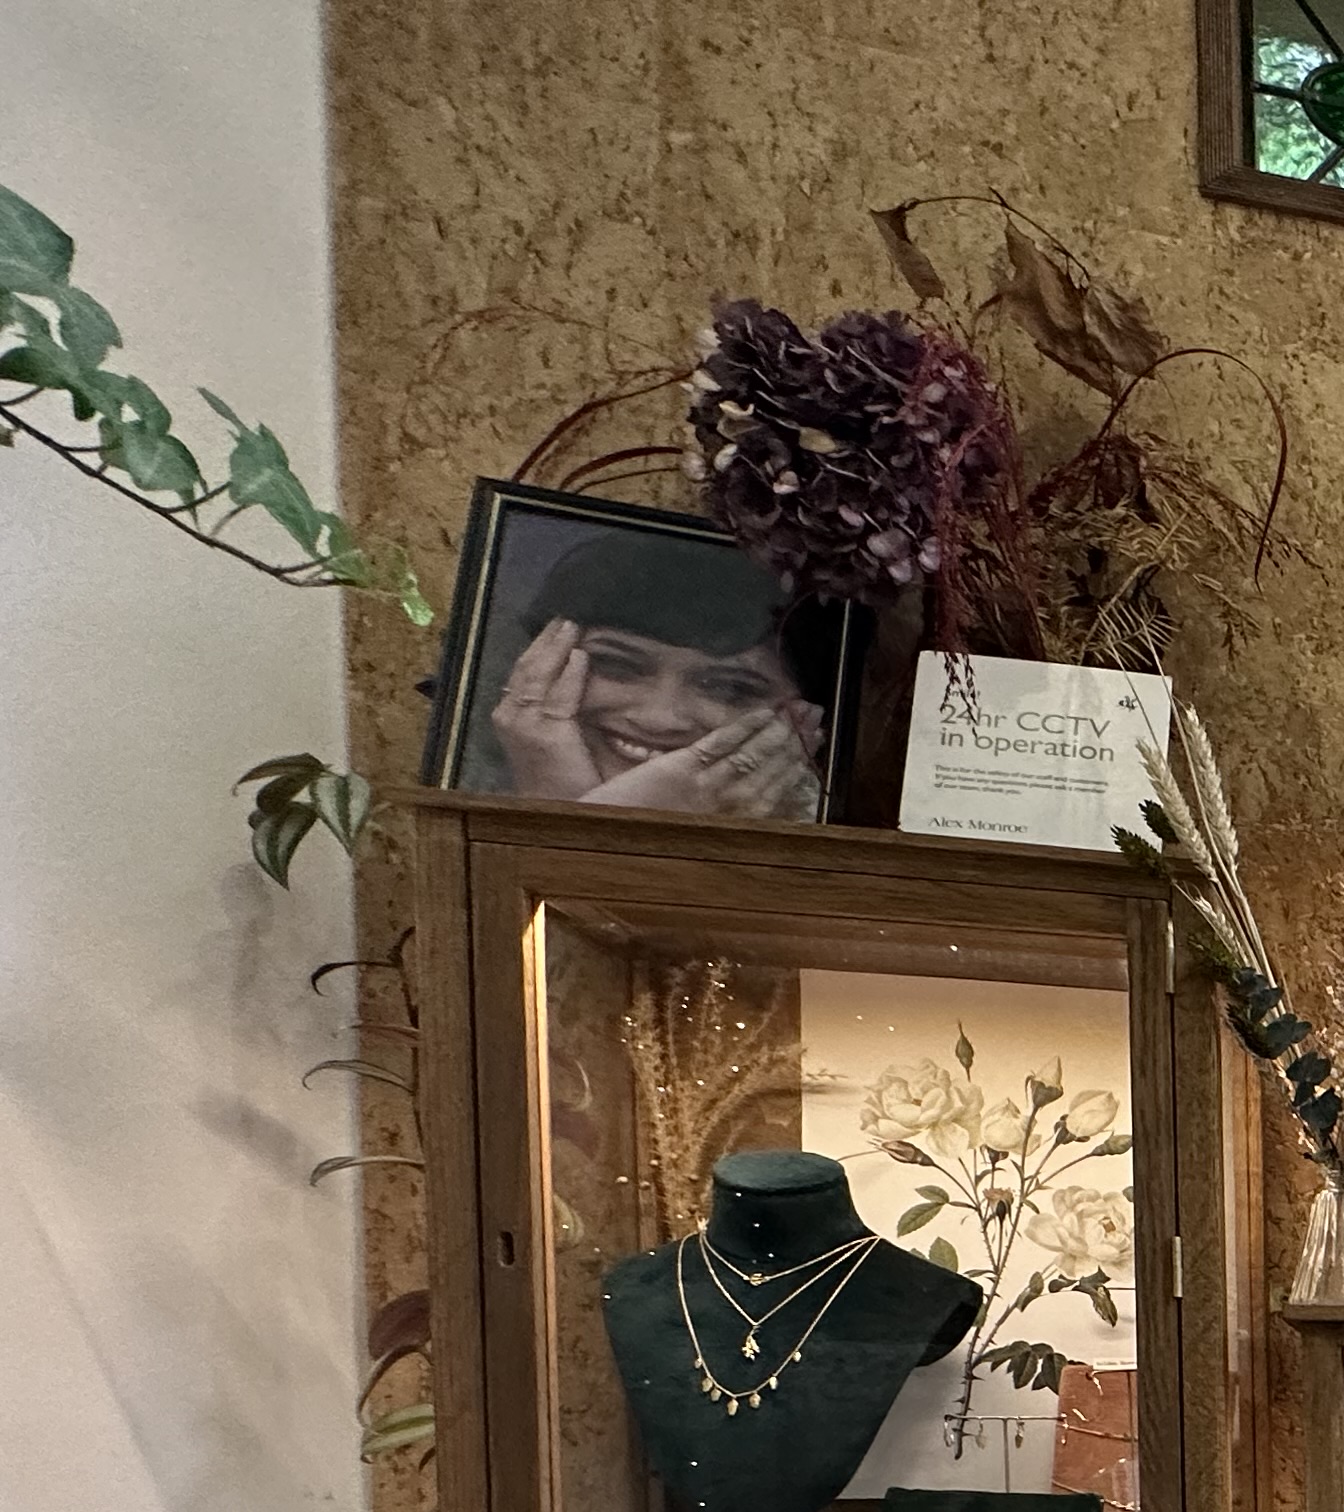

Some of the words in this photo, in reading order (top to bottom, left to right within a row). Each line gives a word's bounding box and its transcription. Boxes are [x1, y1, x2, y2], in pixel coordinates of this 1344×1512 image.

[940, 704, 1007, 729] 24hr
[1016, 711, 1111, 739] CCTV
[940, 727, 964, 747] in
[974, 734, 1114, 762] operation
[928, 816, 963, 829] Alex
[968, 818, 1028, 833] Monroe
